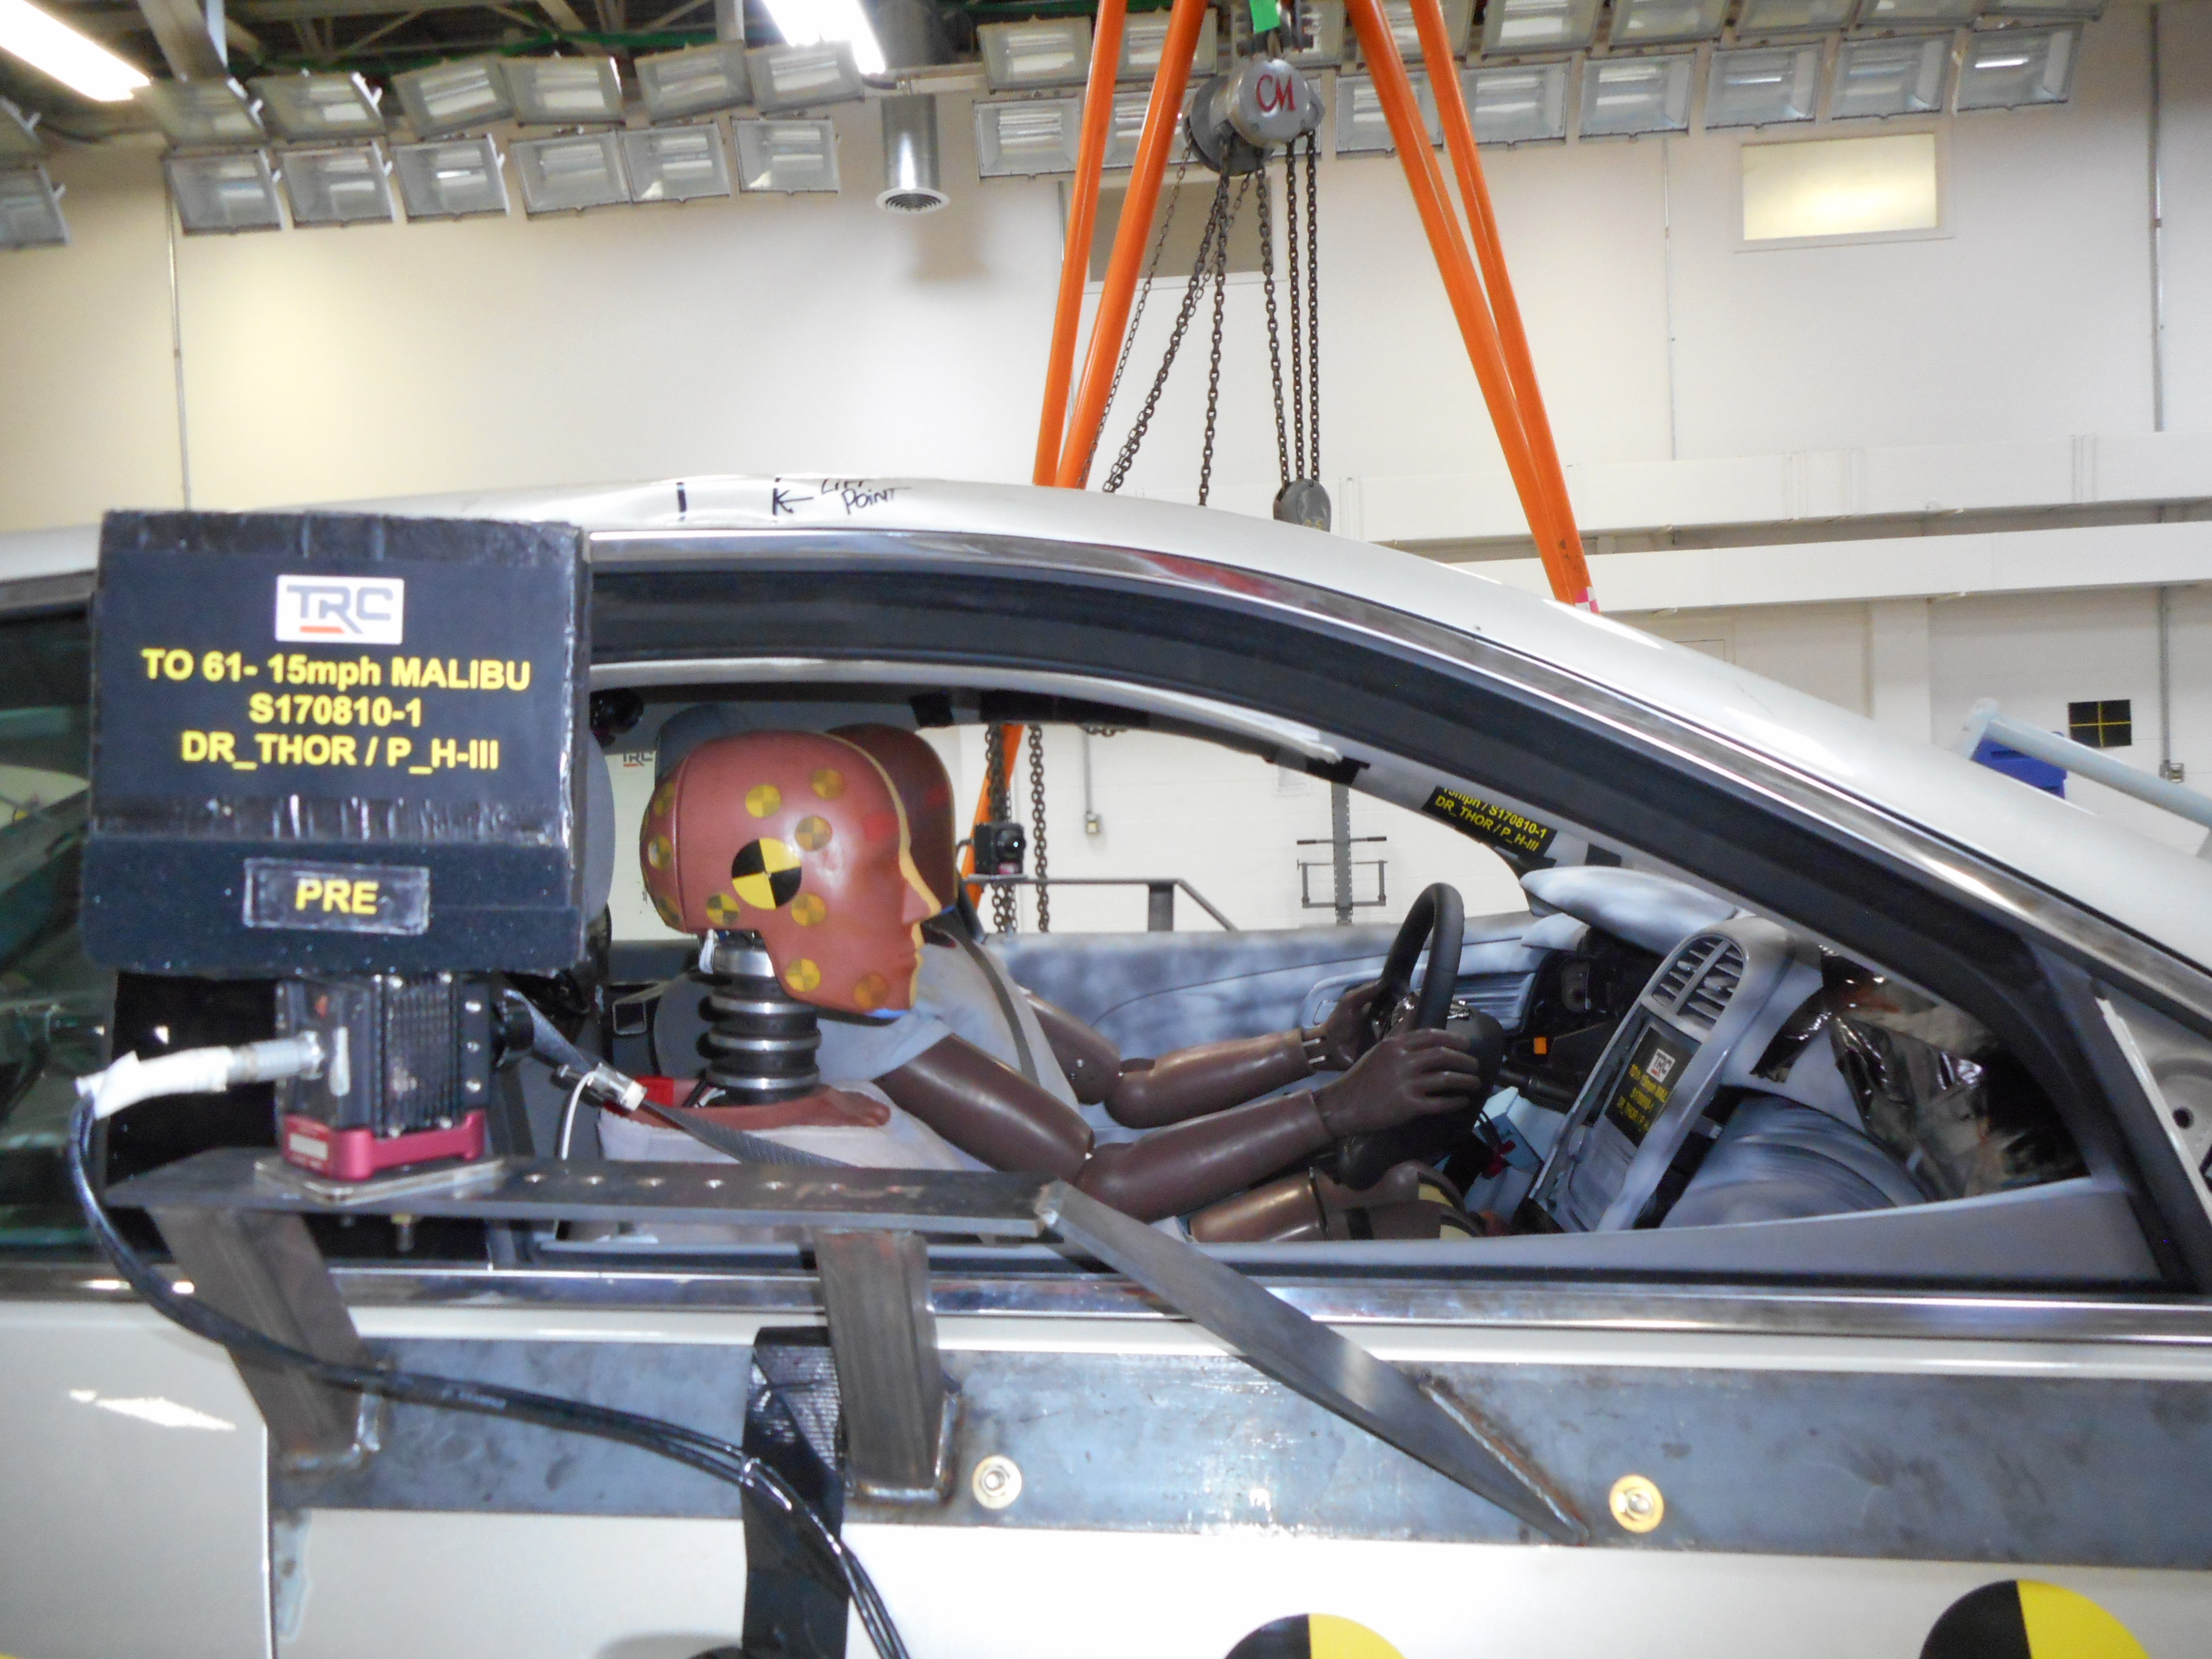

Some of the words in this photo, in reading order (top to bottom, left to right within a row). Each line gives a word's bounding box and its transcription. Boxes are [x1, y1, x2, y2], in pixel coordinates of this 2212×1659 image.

[1256, 73, 1296, 113] CM
[287, 585, 394, 634] TRC
[141, 648, 194, 680] TO
[202, 651, 259, 682] 61-
[267, 653, 381, 692] 15mph
[391, 656, 531, 691] MALIBU
[249, 692, 421, 728] S170810-1
[182, 730, 357, 770] DR_THOR
[364, 736, 379, 766] /
[387, 737, 499, 774] P_H-III
[1489, 805, 1547, 839] S170810-1
[295, 877, 380, 915] PRE
